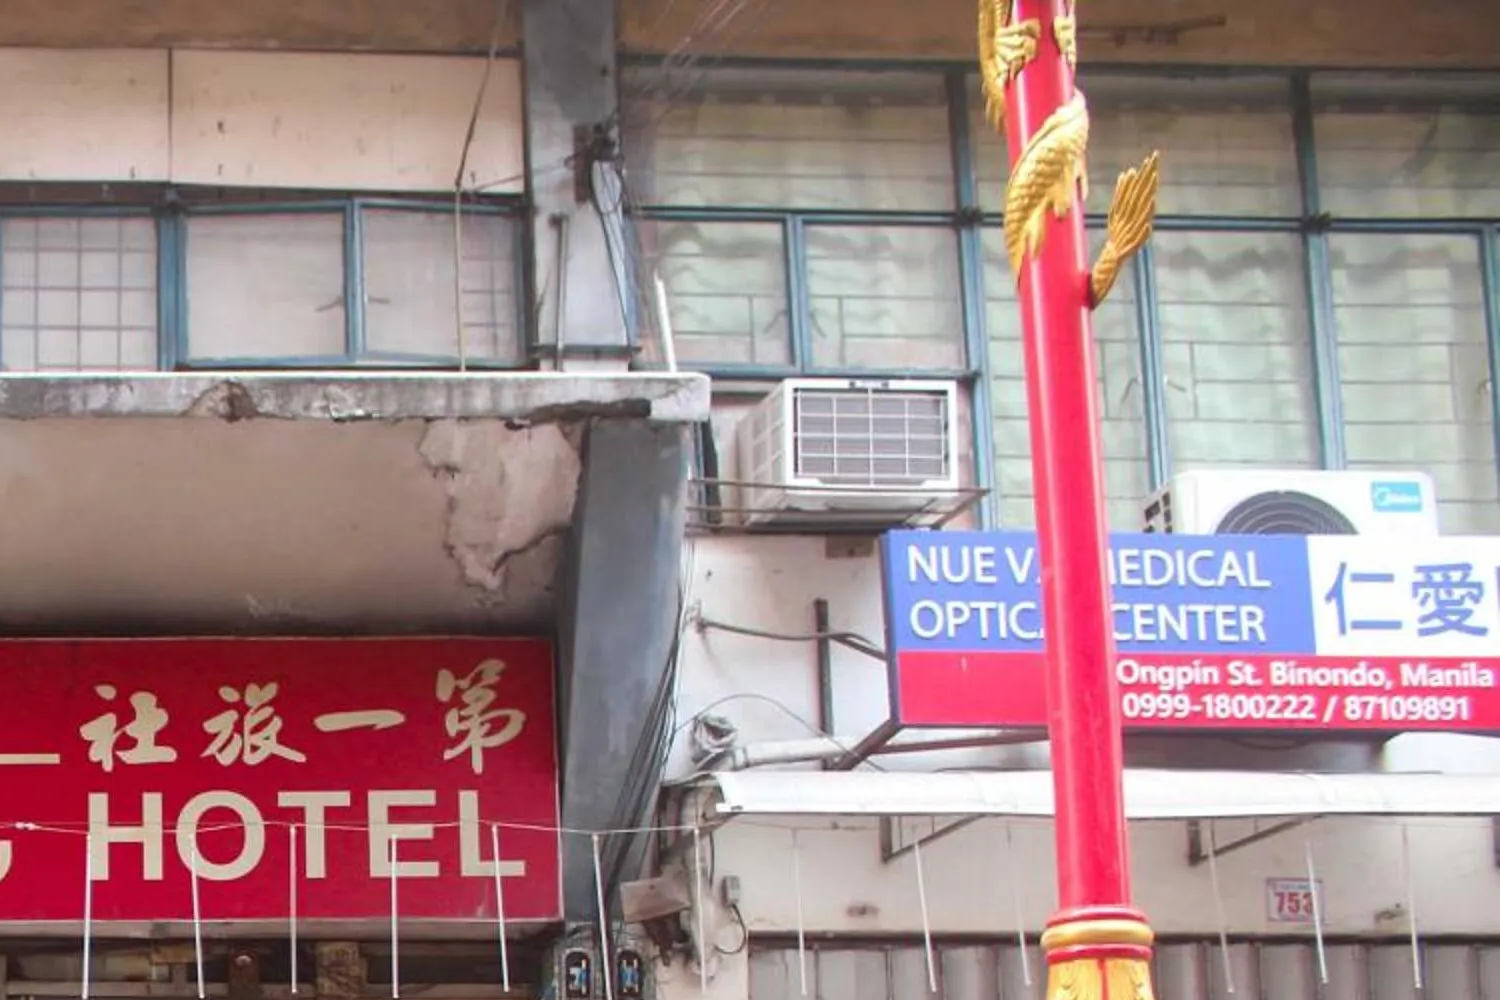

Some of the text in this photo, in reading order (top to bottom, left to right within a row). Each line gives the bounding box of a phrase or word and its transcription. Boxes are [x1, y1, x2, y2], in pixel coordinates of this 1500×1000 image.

[908, 546, 997, 583] NUE
[1325, 561, 1500, 638] 仁愛
[910, 600, 1267, 642] OPTIC CENTER
[1116, 659, 1494, 691] Ongpin St. Binondo, Manila
[1122, 693, 1471, 722] 0999-1800222 / 87109891
[88, 789, 526, 881] HOTEL
